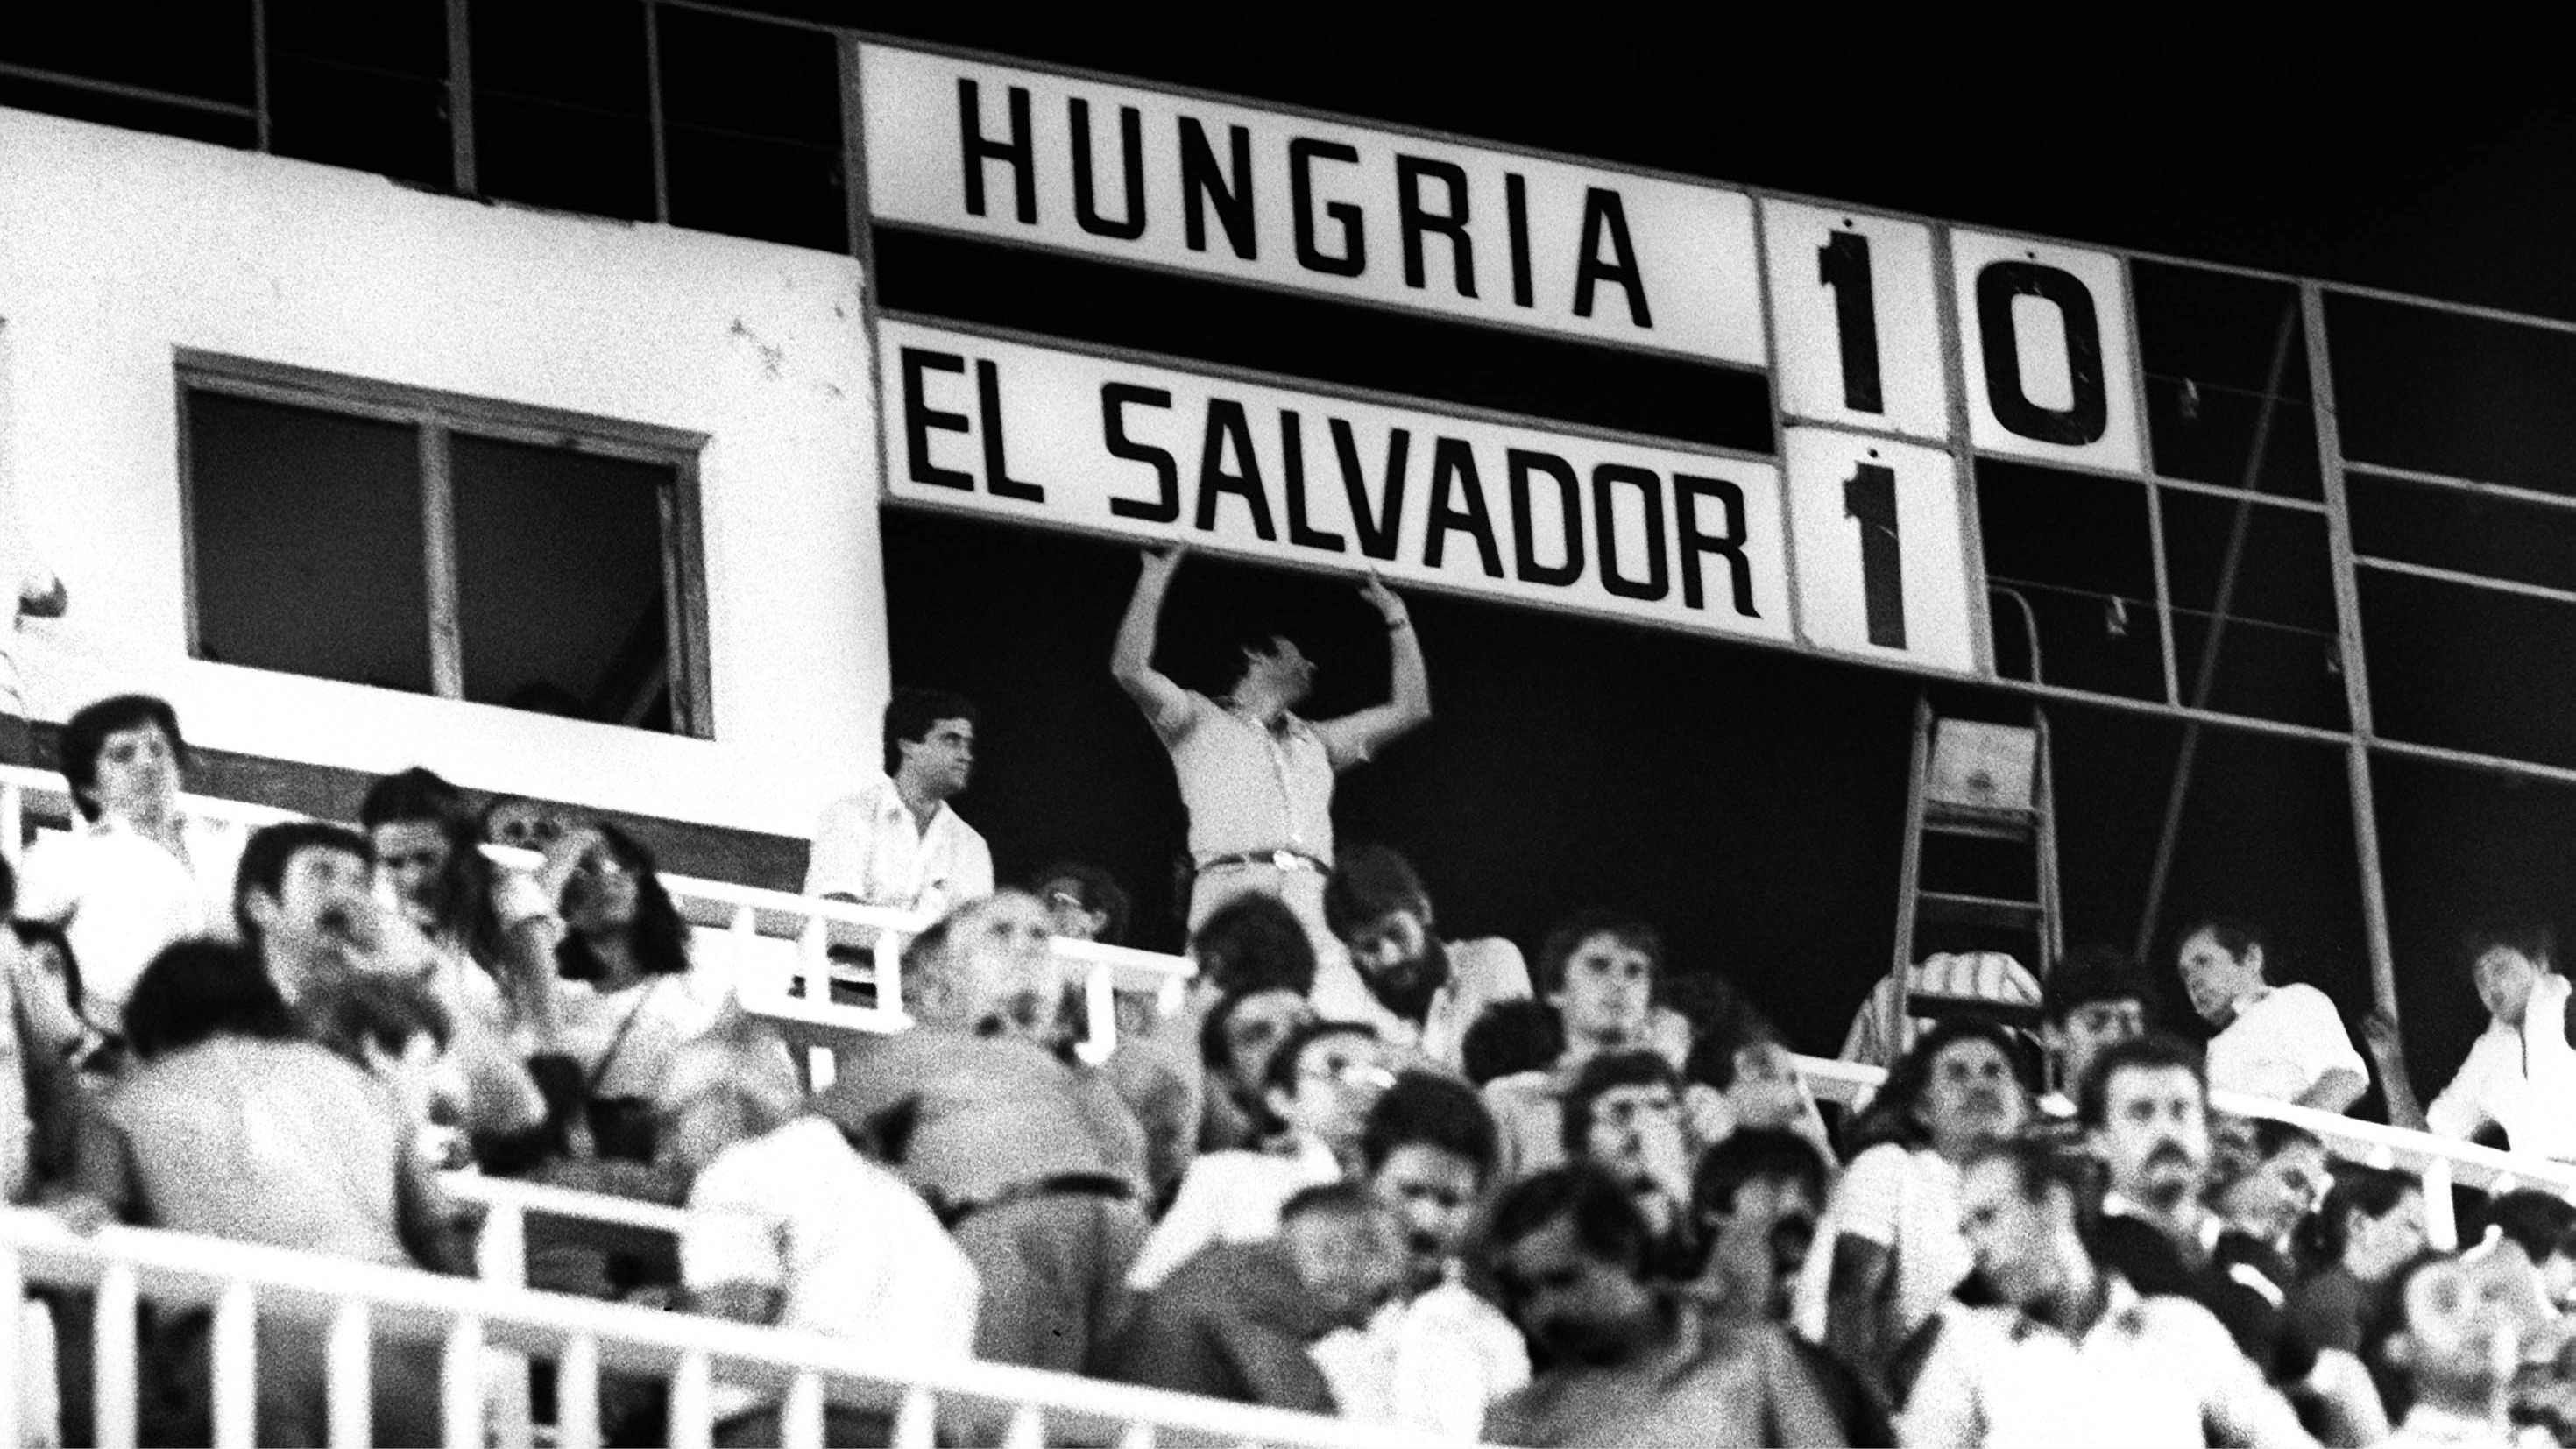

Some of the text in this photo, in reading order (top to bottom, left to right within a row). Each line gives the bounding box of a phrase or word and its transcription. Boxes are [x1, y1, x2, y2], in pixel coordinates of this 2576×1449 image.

[956, 76, 1654, 329] HUNGRIA
[899, 345, 1907, 651] EL SALVADOR 1
